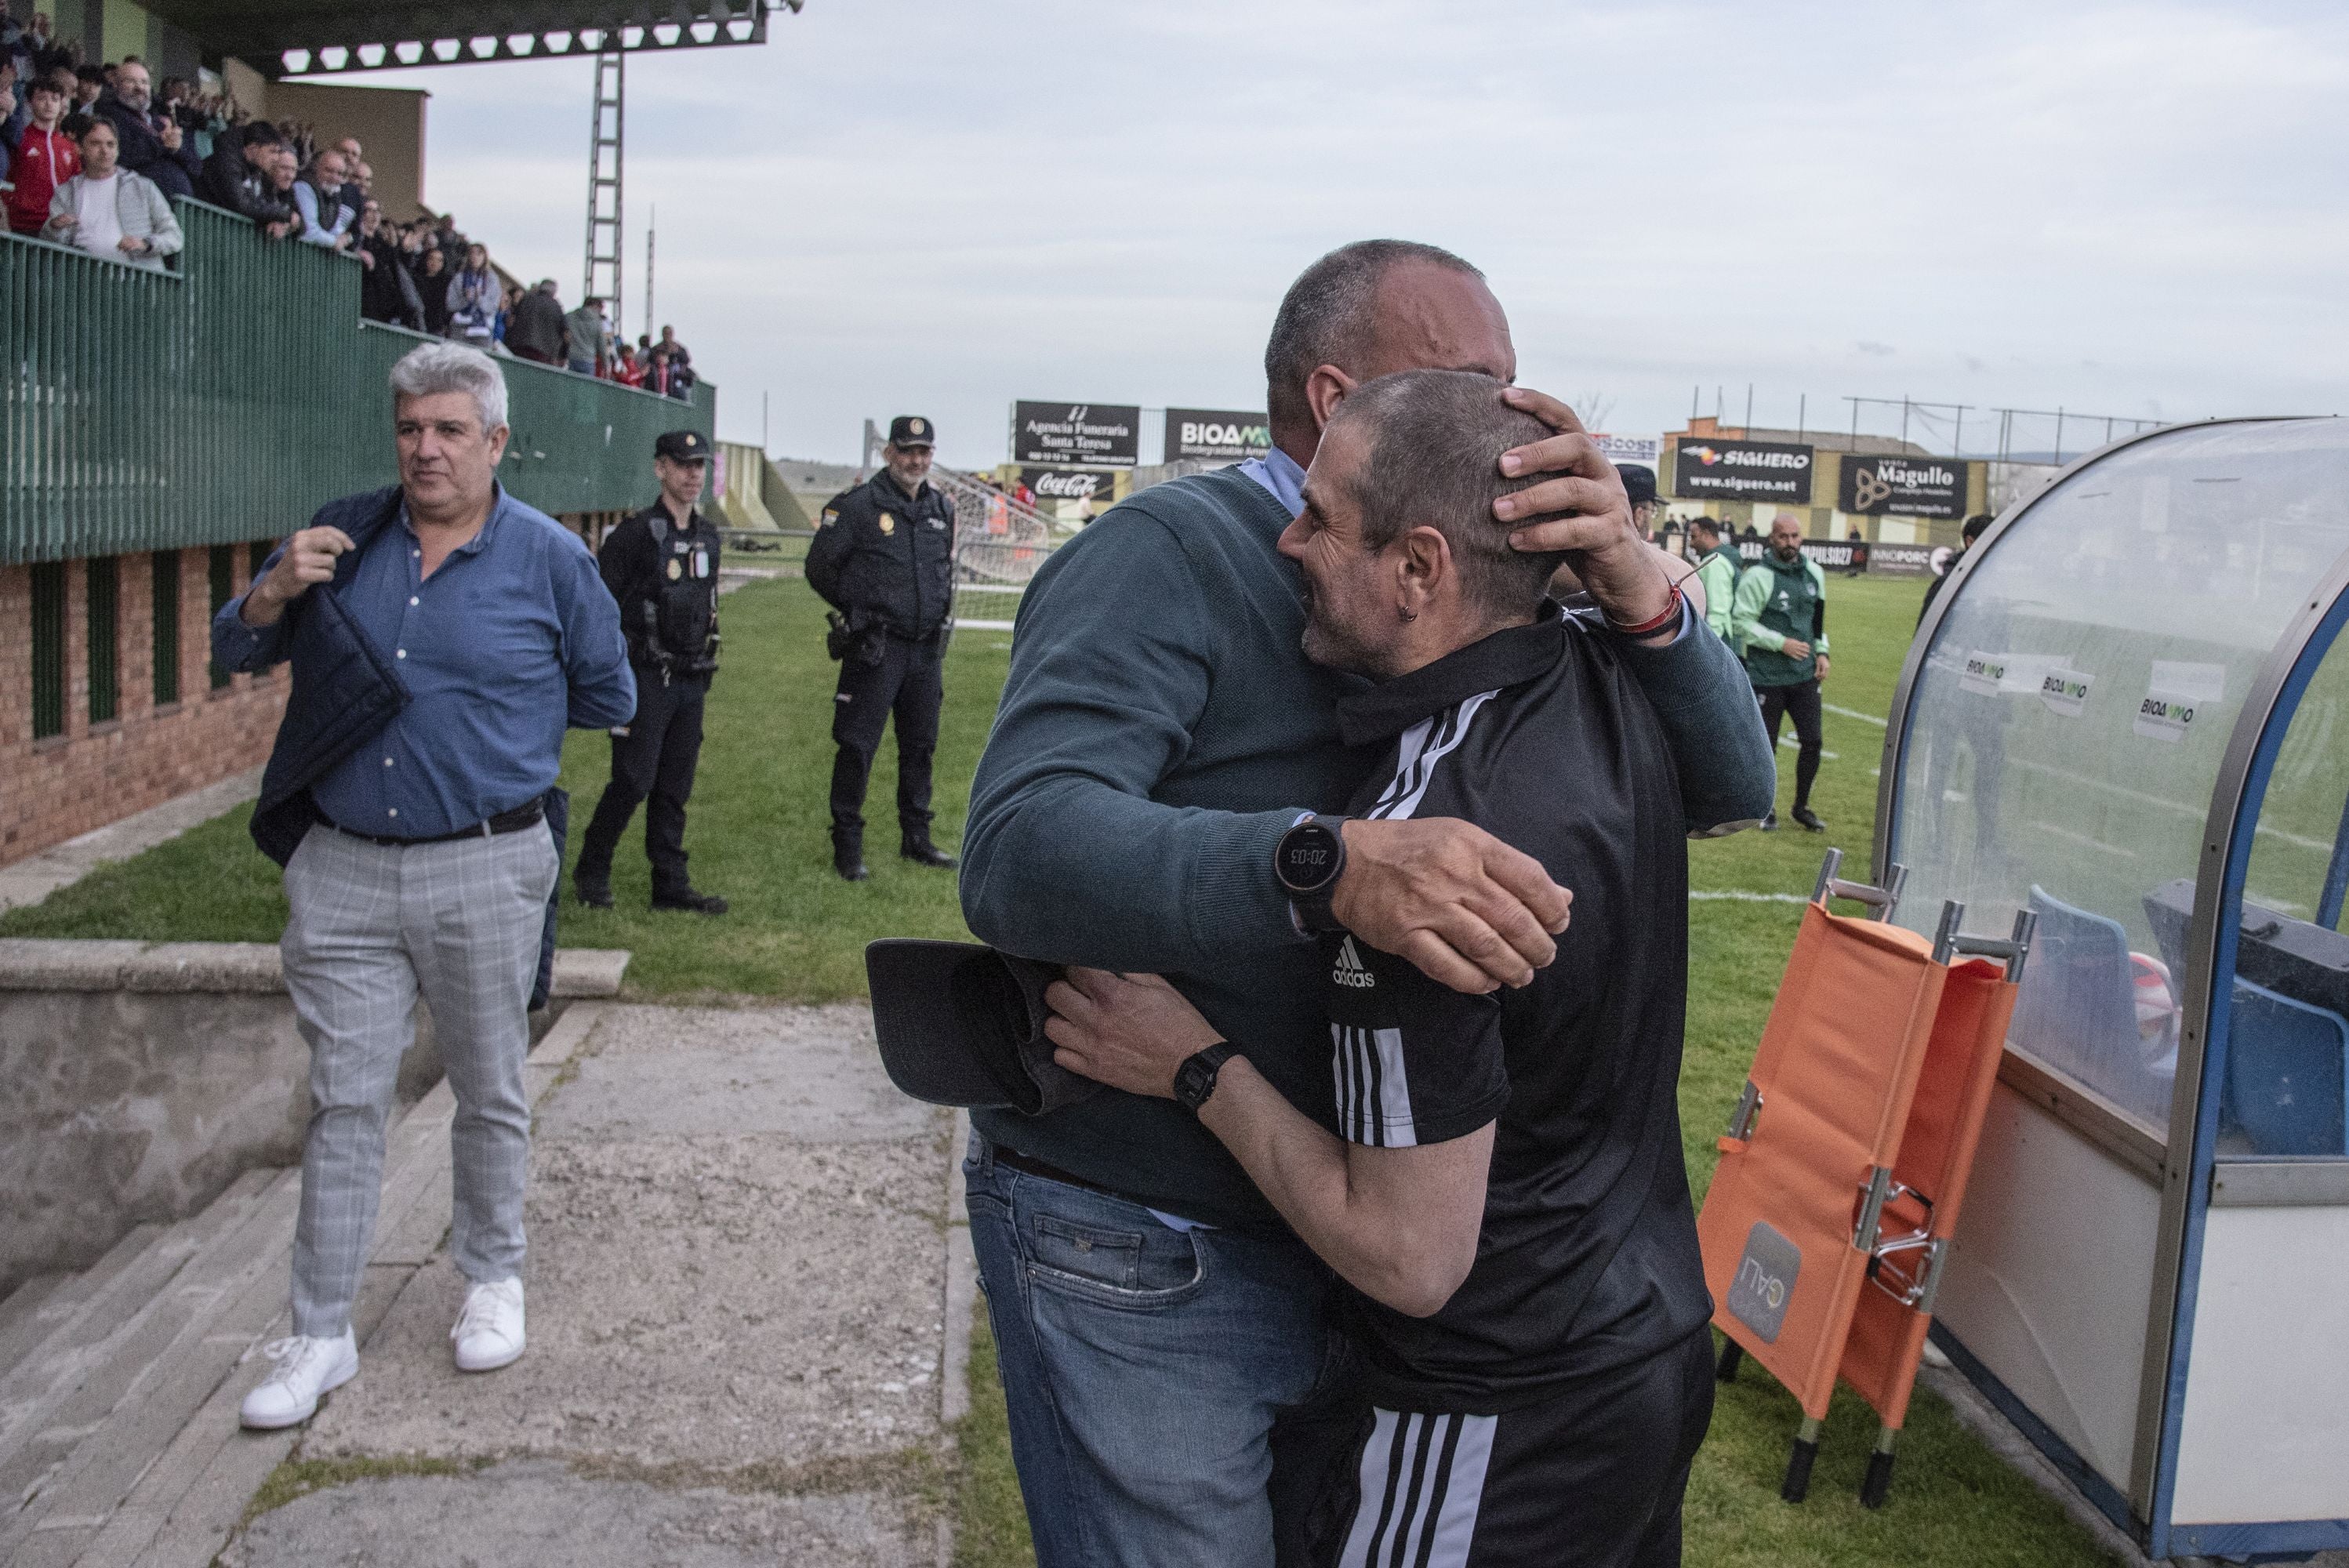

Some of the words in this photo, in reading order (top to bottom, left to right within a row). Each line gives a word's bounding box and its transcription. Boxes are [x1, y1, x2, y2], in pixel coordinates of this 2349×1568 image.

[1026, 419, 1073, 436] Agencia
[1075, 421, 1129, 437] Funeraria
[1041, 434, 1074, 448] Santa
[1075, 435, 1113, 450] Teresa
[1690, 476, 1797, 492] www.siguero.net
[1876, 466, 1955, 489] Magullo
[1872, 549, 1930, 564] INNOPORC
[1333, 967, 1375, 988] adidas
